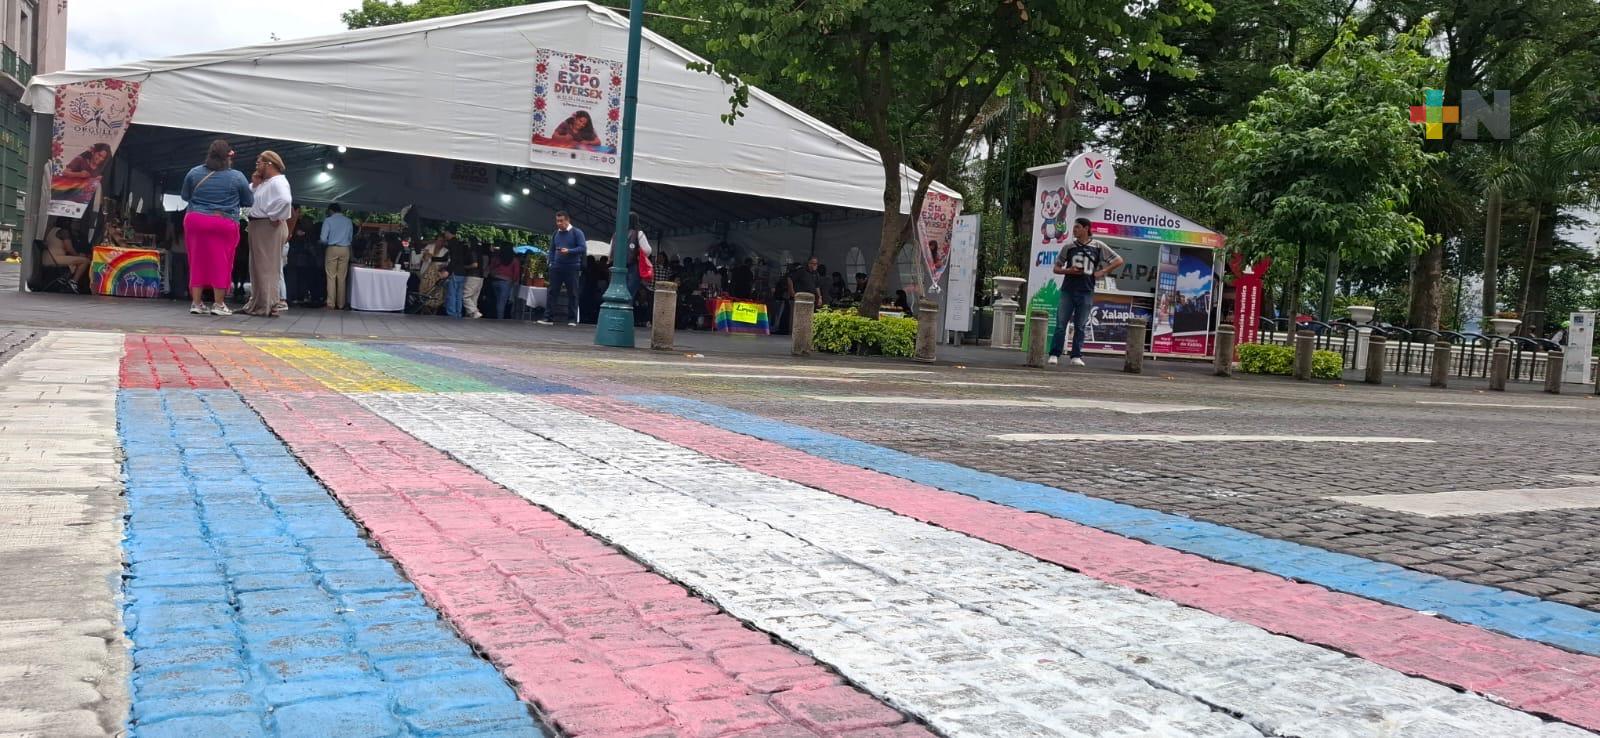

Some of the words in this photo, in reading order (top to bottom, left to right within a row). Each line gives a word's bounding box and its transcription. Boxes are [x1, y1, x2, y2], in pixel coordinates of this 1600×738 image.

[568, 60, 592, 75] 5ta
[558, 71, 600, 88] EXPO
[554, 83, 603, 100] DIVERSEX
[1072, 180, 1109, 195] Xalapa
[922, 211, 947, 222] EXPO
[1103, 208, 1181, 229] Bienvenidos
[1036, 250, 1058, 267] CHIT
[1102, 309, 1135, 322] Xalapa
